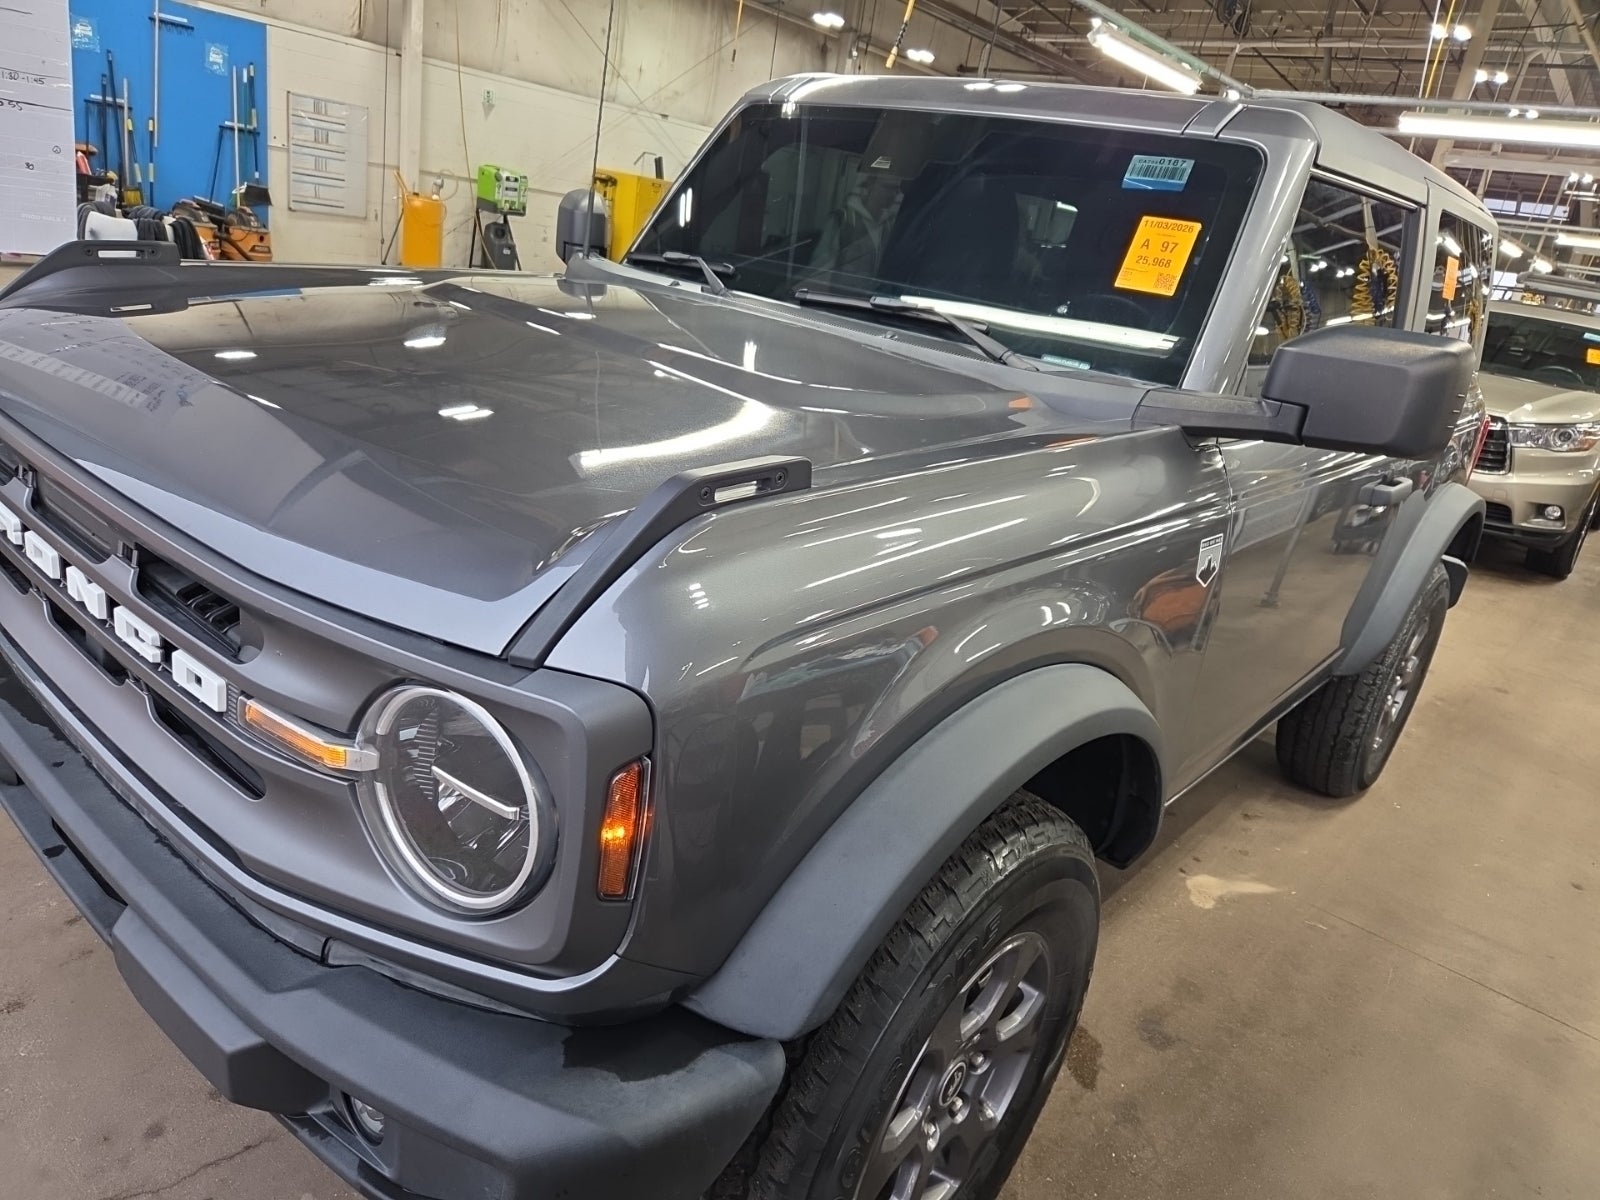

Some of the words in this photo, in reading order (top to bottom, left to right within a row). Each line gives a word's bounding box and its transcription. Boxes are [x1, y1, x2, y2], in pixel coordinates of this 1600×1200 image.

[1143, 219, 1194, 234] 11/03/2026
[1140, 238, 1150, 250] A
[1160, 240, 1179, 254] 97
